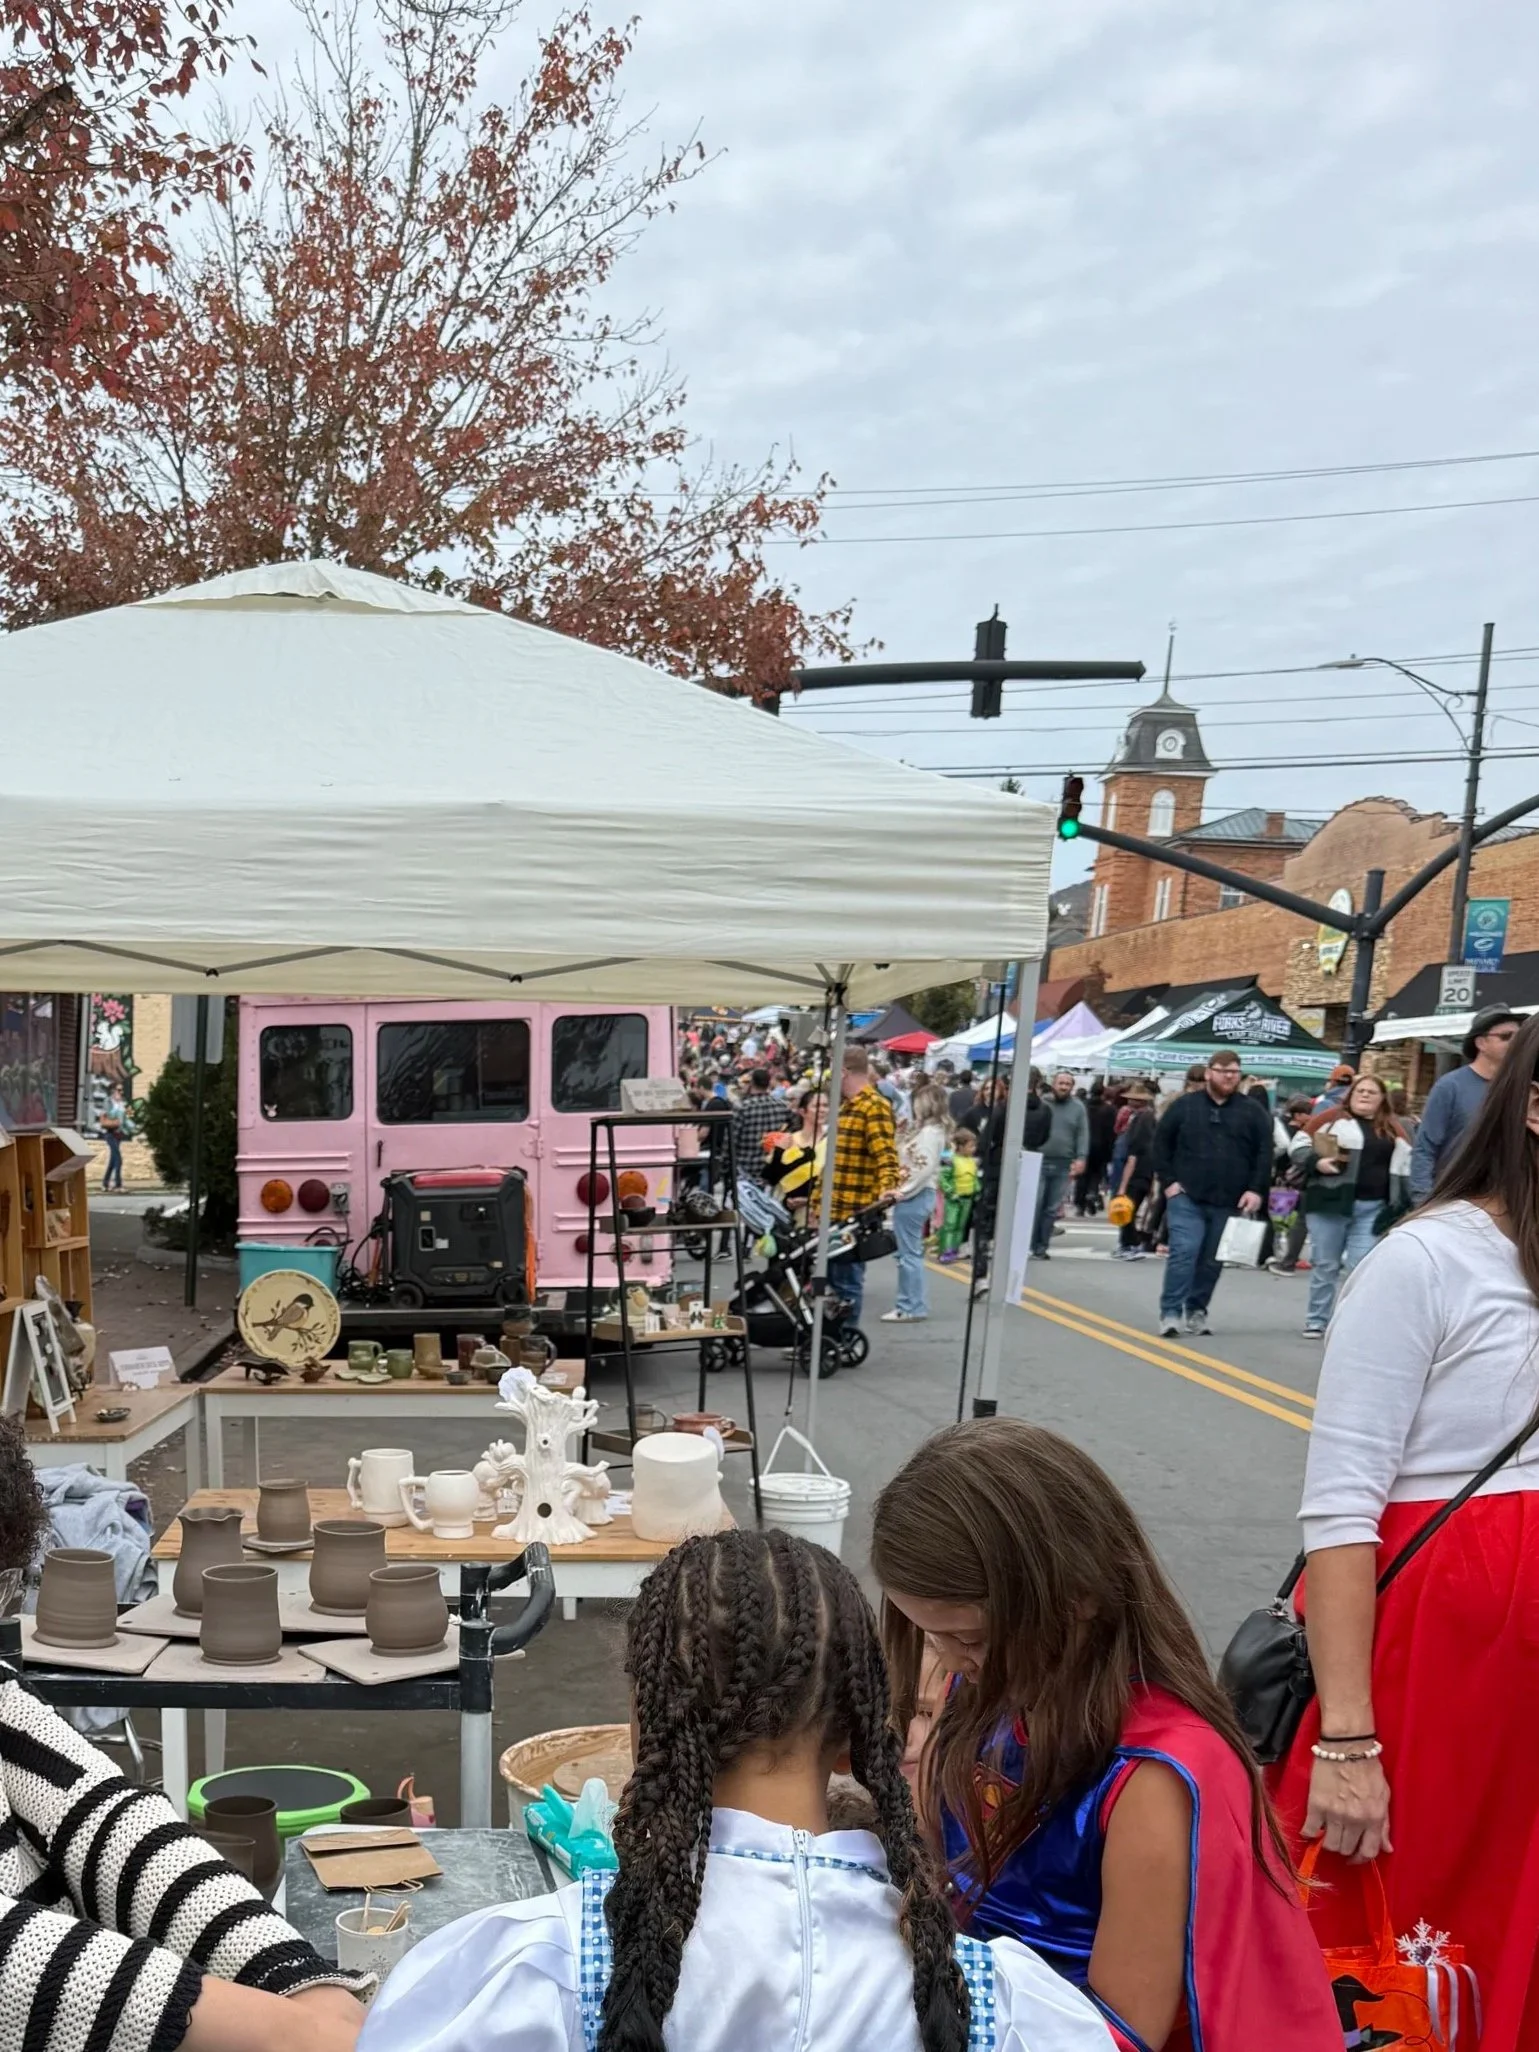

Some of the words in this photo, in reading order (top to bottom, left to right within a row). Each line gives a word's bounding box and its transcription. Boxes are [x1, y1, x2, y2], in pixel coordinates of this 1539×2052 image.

[1447, 970, 1471, 978] SPEED
[1444, 988, 1470, 1002] 20
[1212, 1015, 1246, 1031] FORKS
[1261, 1018, 1291, 1036] RIVER
